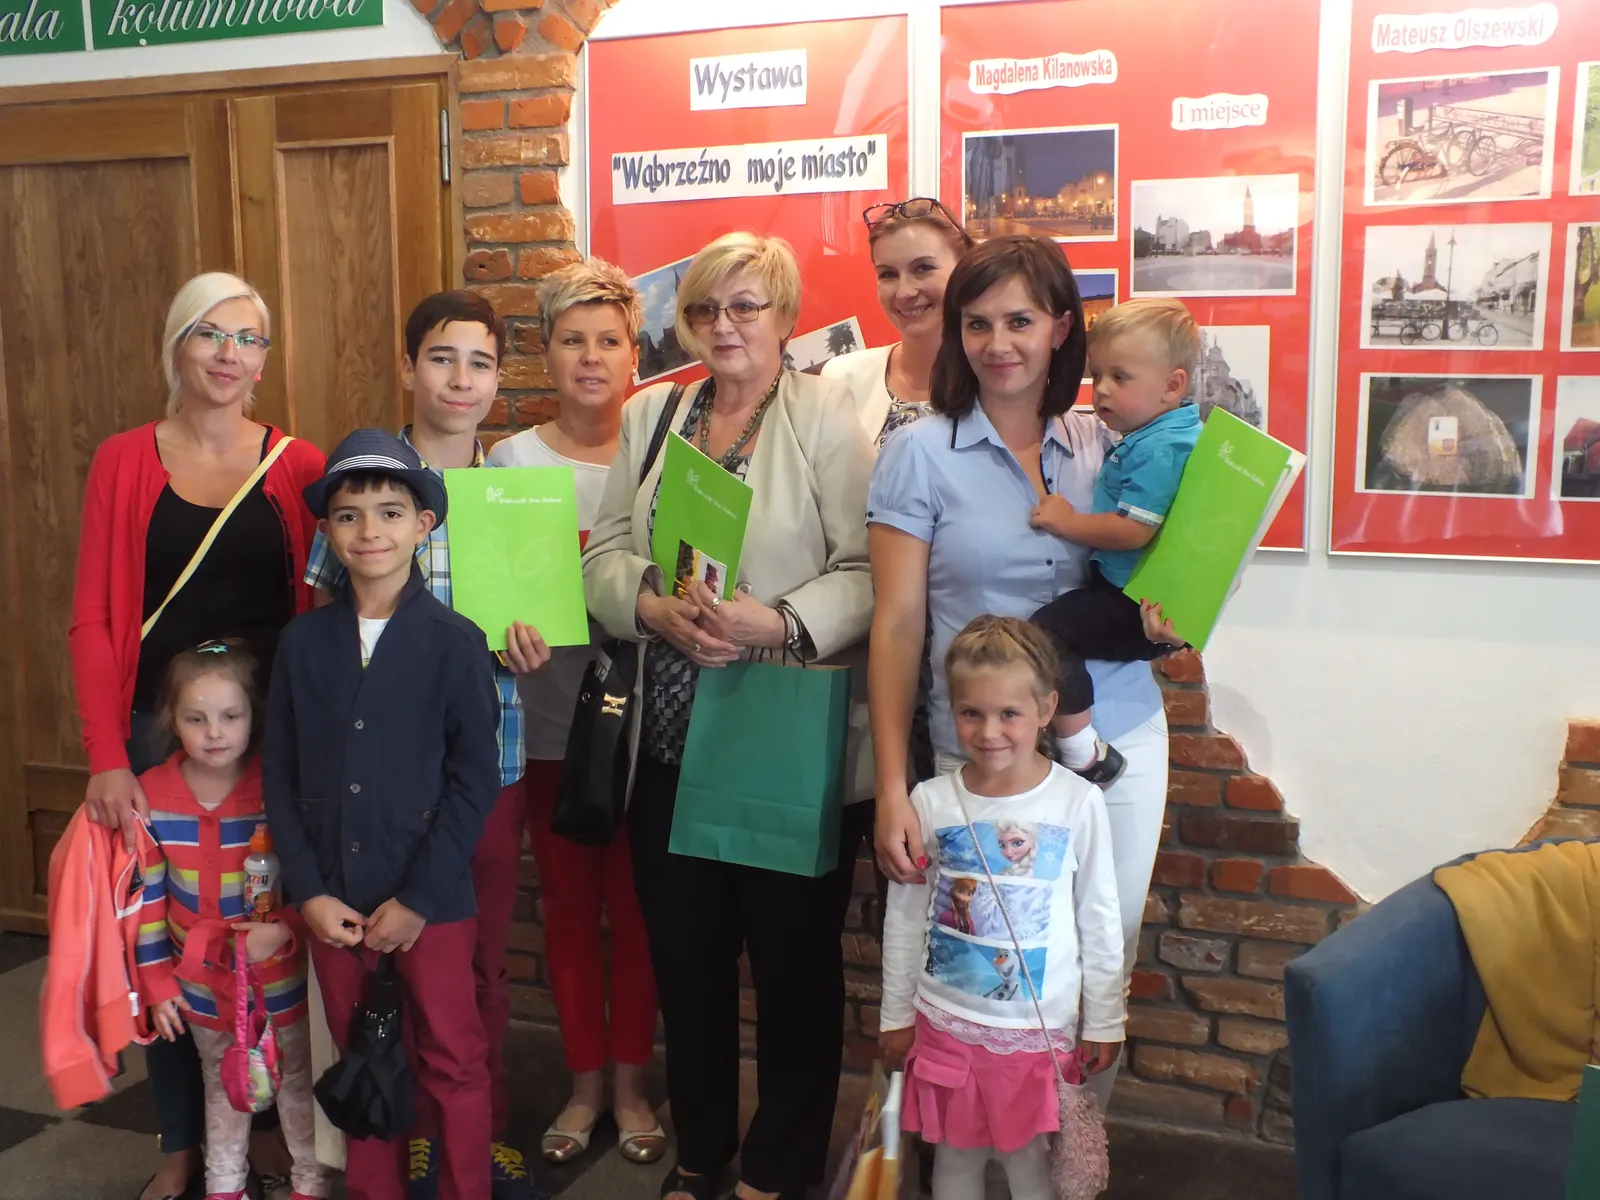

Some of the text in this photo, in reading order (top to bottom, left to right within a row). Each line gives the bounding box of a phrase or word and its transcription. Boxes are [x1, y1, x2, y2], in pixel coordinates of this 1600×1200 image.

[1376, 14, 1544, 47] Mateusz Olszewski
[694, 63, 803, 104] Wystawa
[975, 55, 1113, 91] Magdalena Kilanowska
[1178, 99, 1261, 125] I miejsce
[747, 149, 797, 193] moje
[802, 139, 877, 180] miasto"
